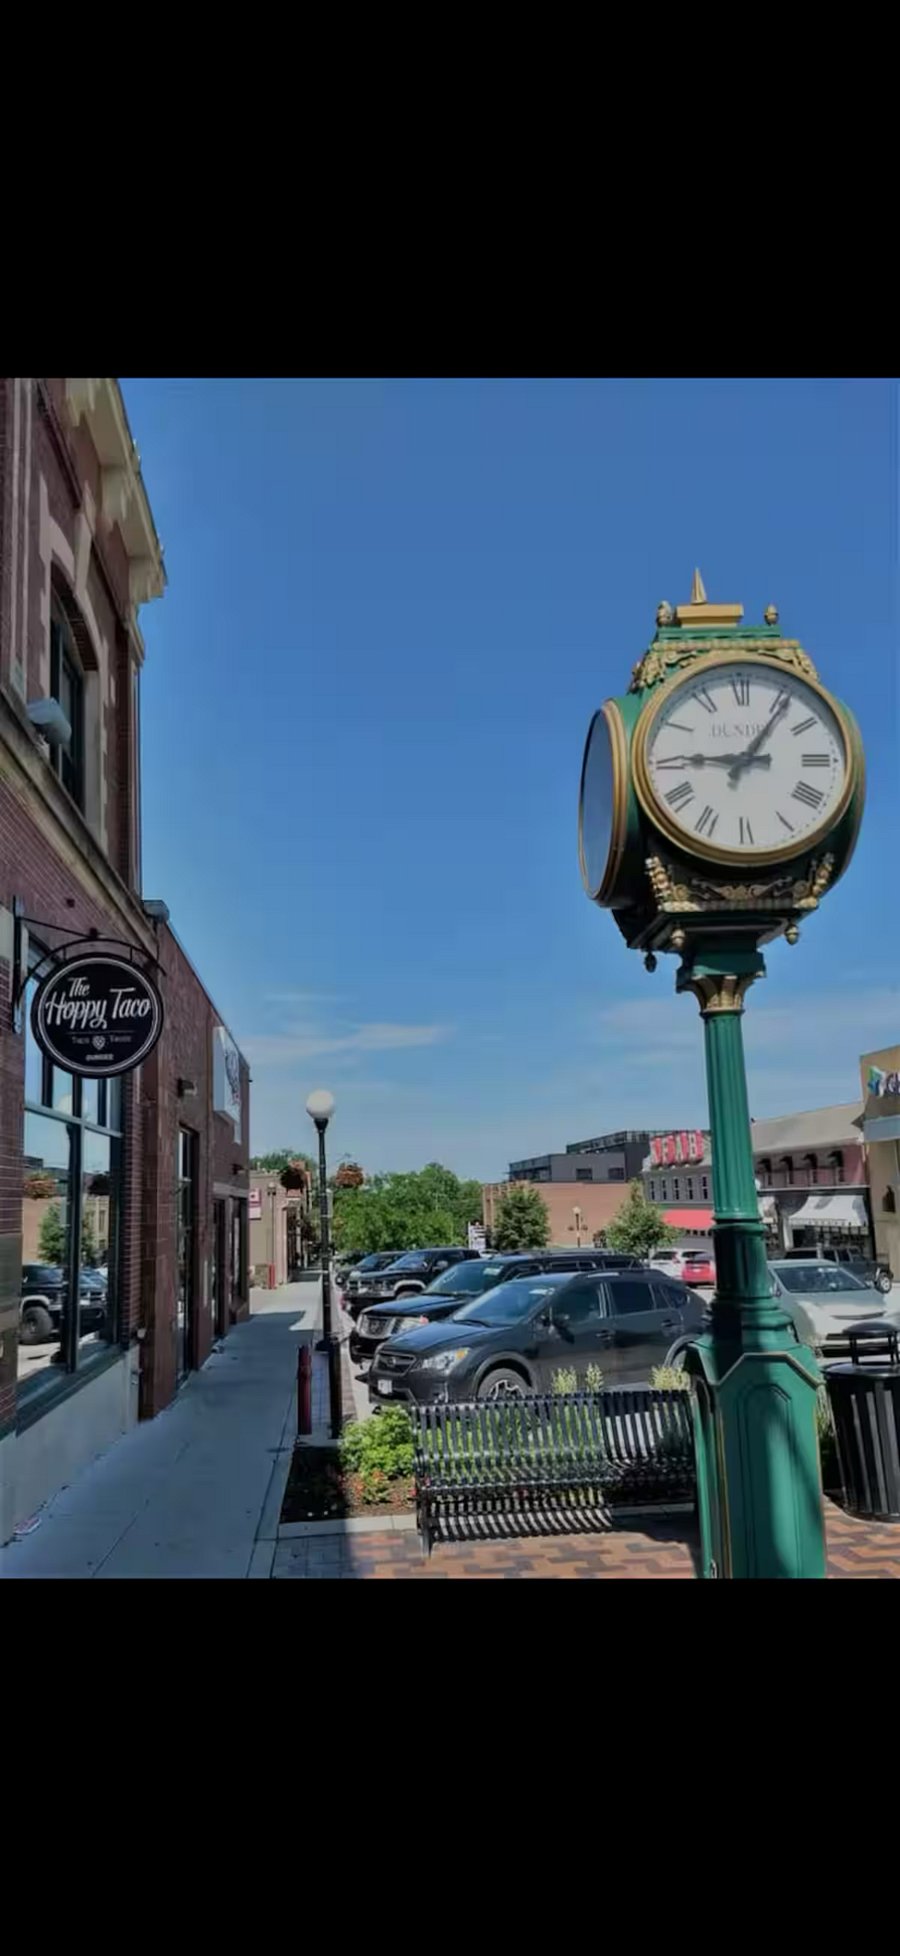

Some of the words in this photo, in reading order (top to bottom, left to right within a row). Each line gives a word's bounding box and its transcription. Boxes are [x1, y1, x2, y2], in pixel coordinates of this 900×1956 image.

[68, 977, 90, 998] The
[45, 991, 107, 1030] Hoppy
[109, 987, 151, 1020] Taco
